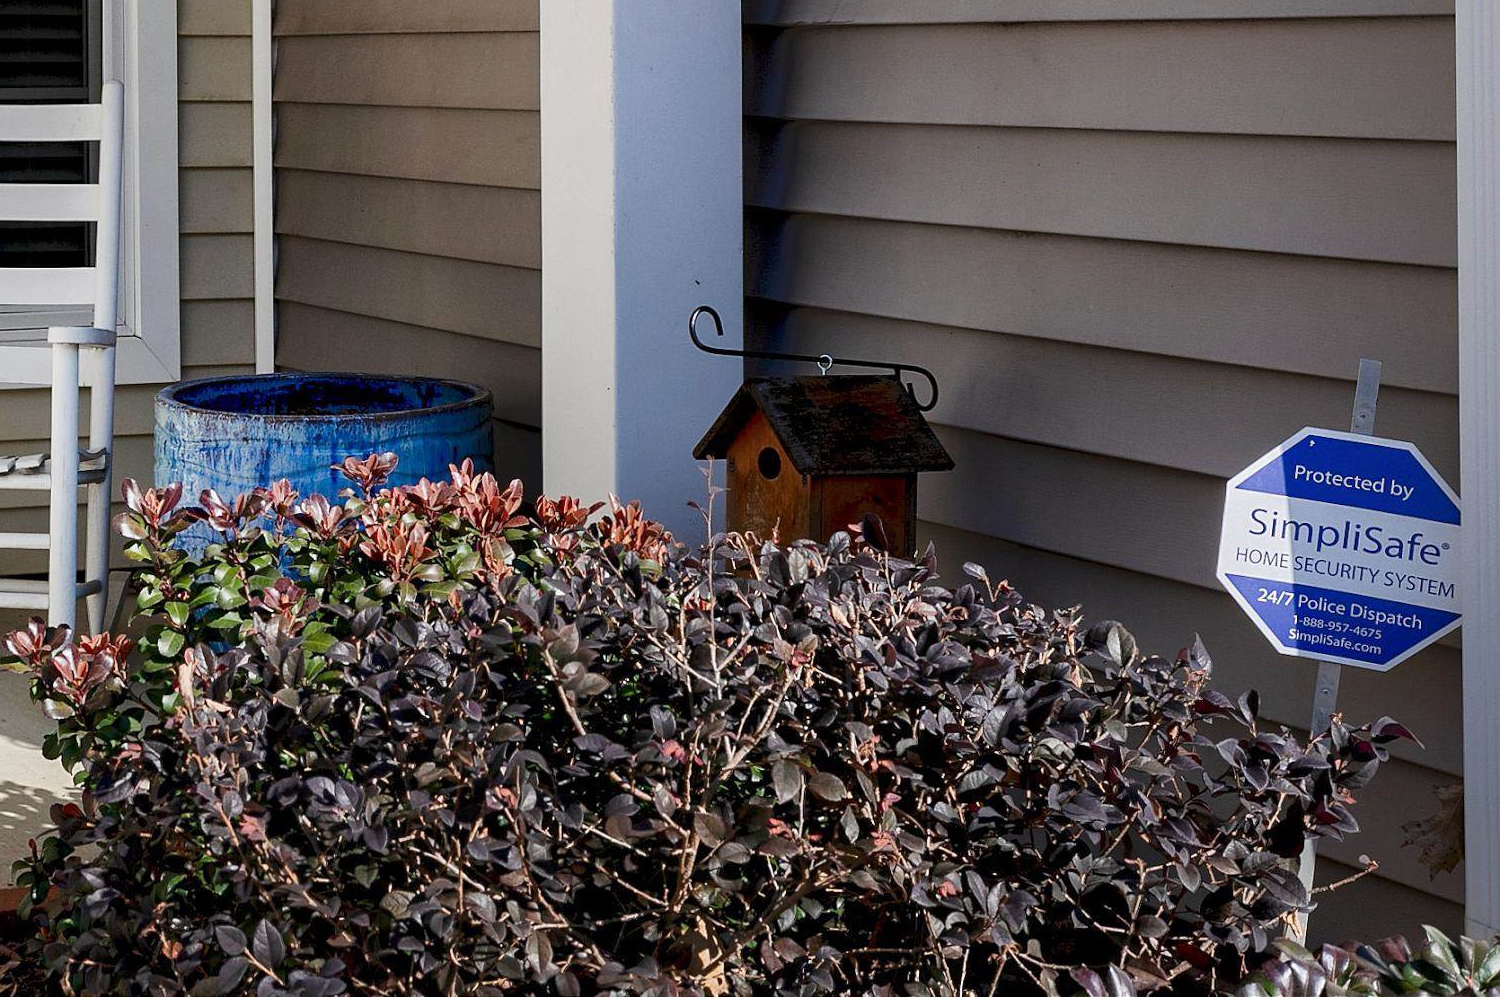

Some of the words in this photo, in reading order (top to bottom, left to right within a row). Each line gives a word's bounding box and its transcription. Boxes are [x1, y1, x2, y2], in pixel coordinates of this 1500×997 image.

[1294, 464, 1385, 494] Protected
[1390, 480, 1414, 502] by
[1236, 547, 1289, 569] HOME
[1294, 556, 1381, 584] SECURITY
[1383, 571, 1456, 599] SYSTEM
[1256, 588, 1295, 607] 24/7
[1297, 594, 1346, 616] Police
[1350, 603, 1423, 630] Dispatch
[1293, 615, 1382, 640] 1-888-957-4675
[1288, 628, 1382, 655] SimpliSafe.com
